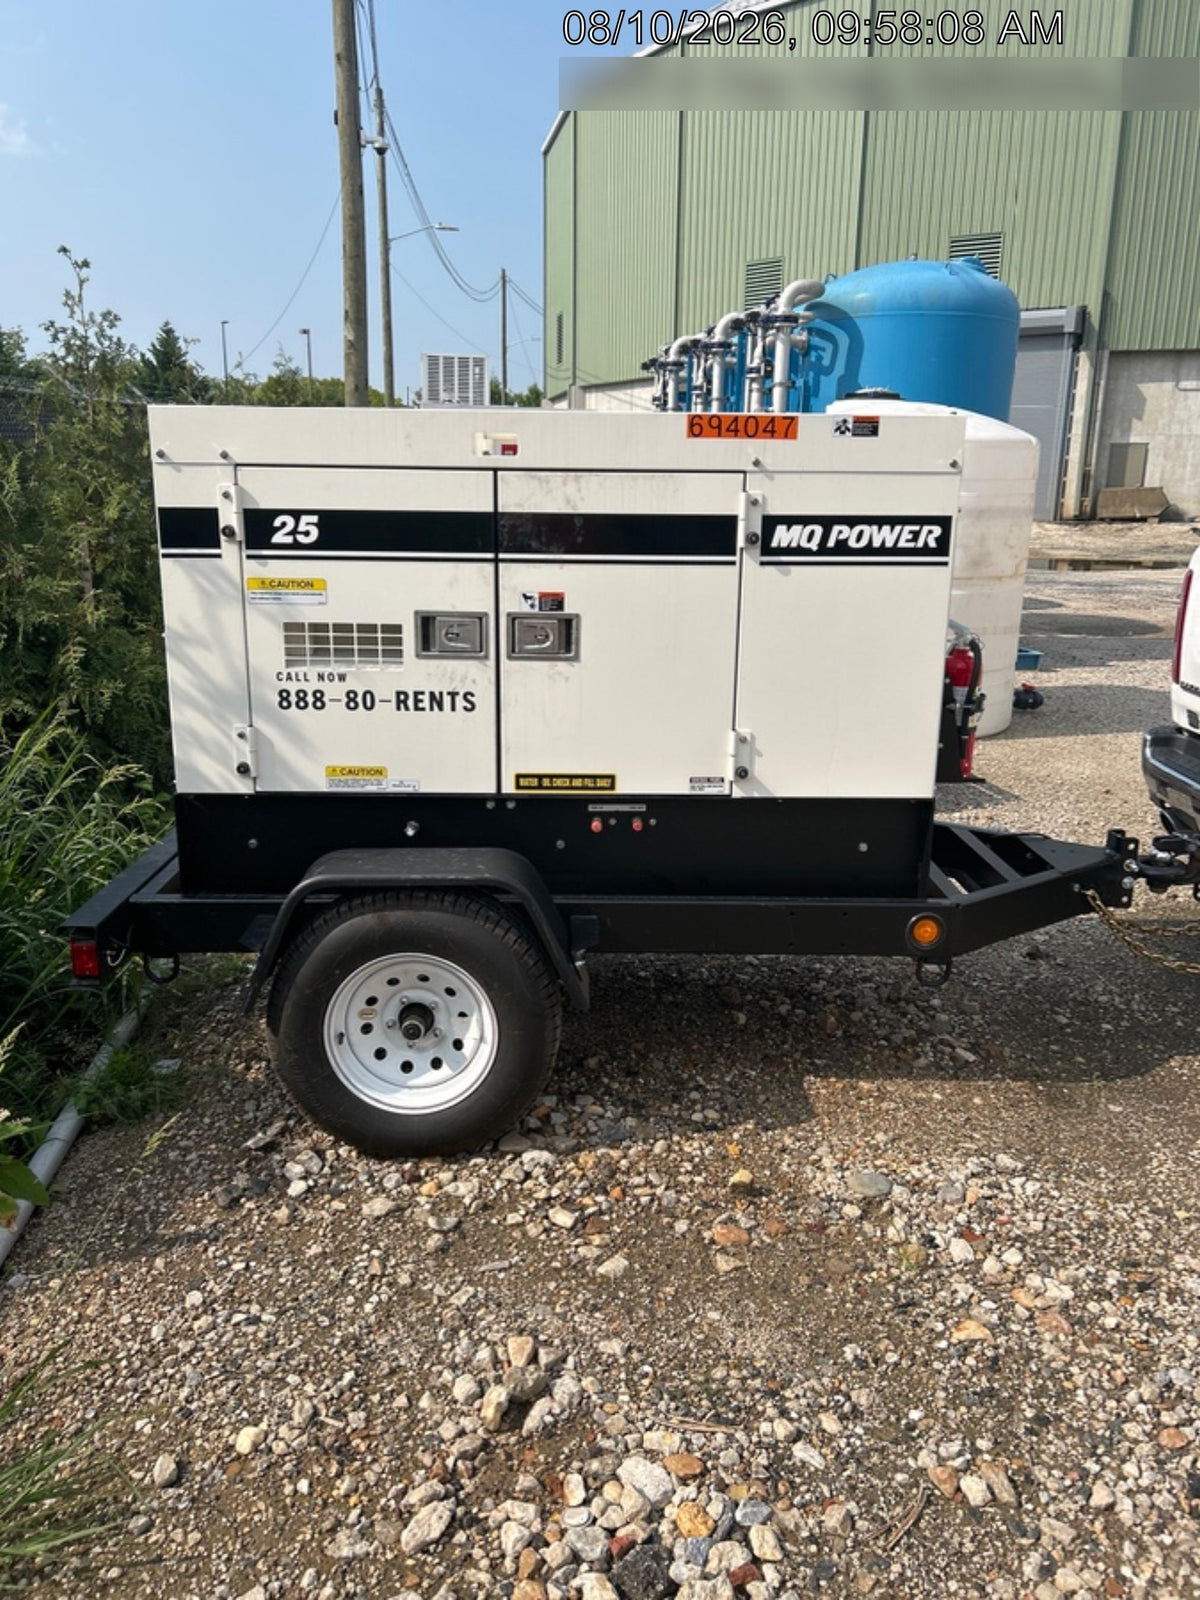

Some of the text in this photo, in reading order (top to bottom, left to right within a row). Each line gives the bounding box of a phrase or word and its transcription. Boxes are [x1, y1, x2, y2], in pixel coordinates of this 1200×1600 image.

[690, 414, 796, 438] 694047
[270, 514, 319, 544] 25
[770, 524, 942, 551] MQ POWER
[269, 579, 314, 589] CAUTION
[276, 671, 348, 682] CALL NOW
[340, 767, 383, 776] CAUTION
